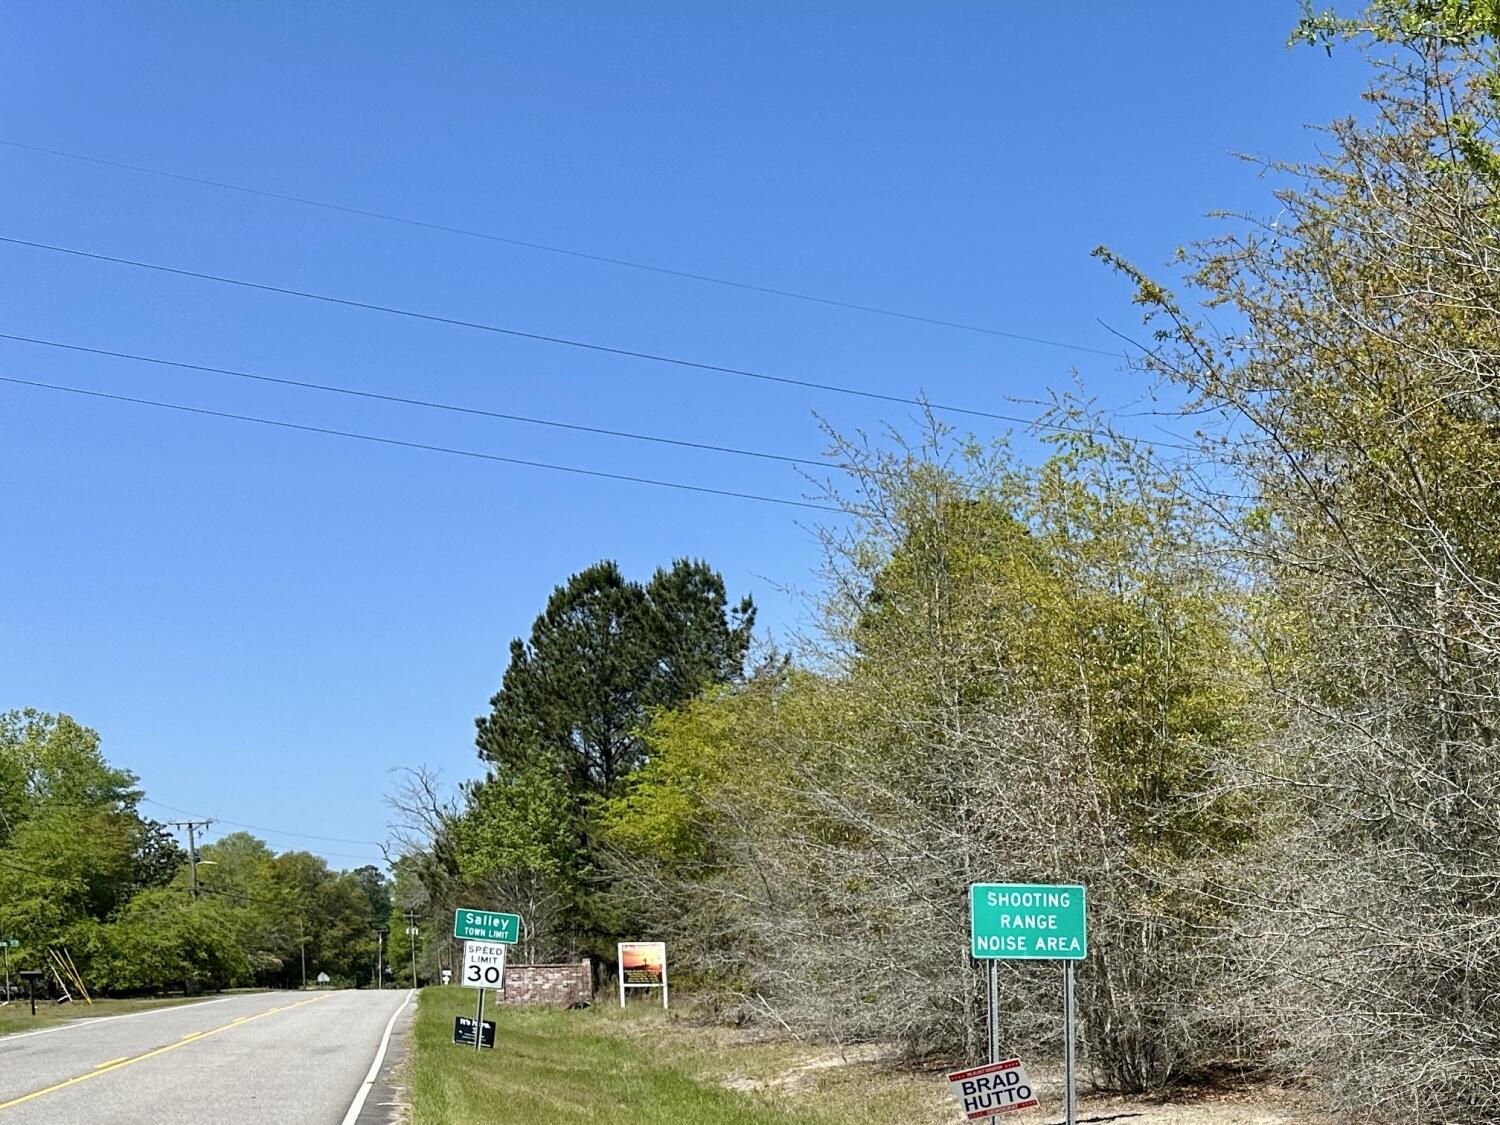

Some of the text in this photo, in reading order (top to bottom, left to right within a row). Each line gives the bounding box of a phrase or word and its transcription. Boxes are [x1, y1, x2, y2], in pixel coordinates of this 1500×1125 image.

[987, 892, 1071, 908] SHOOTING
[465, 912, 510, 930] Salley
[1000, 914, 1058, 929] RANGE
[464, 926, 510, 939] TOWN LIMIT
[468, 945, 503, 956] SPEED
[977, 936, 1081, 951] NOISE AREA
[471, 955, 498, 964] LIMIT
[467, 964, 500, 983] 30
[961, 1071, 1020, 1097] BRAD
[963, 1085, 1032, 1112] HUTTO
